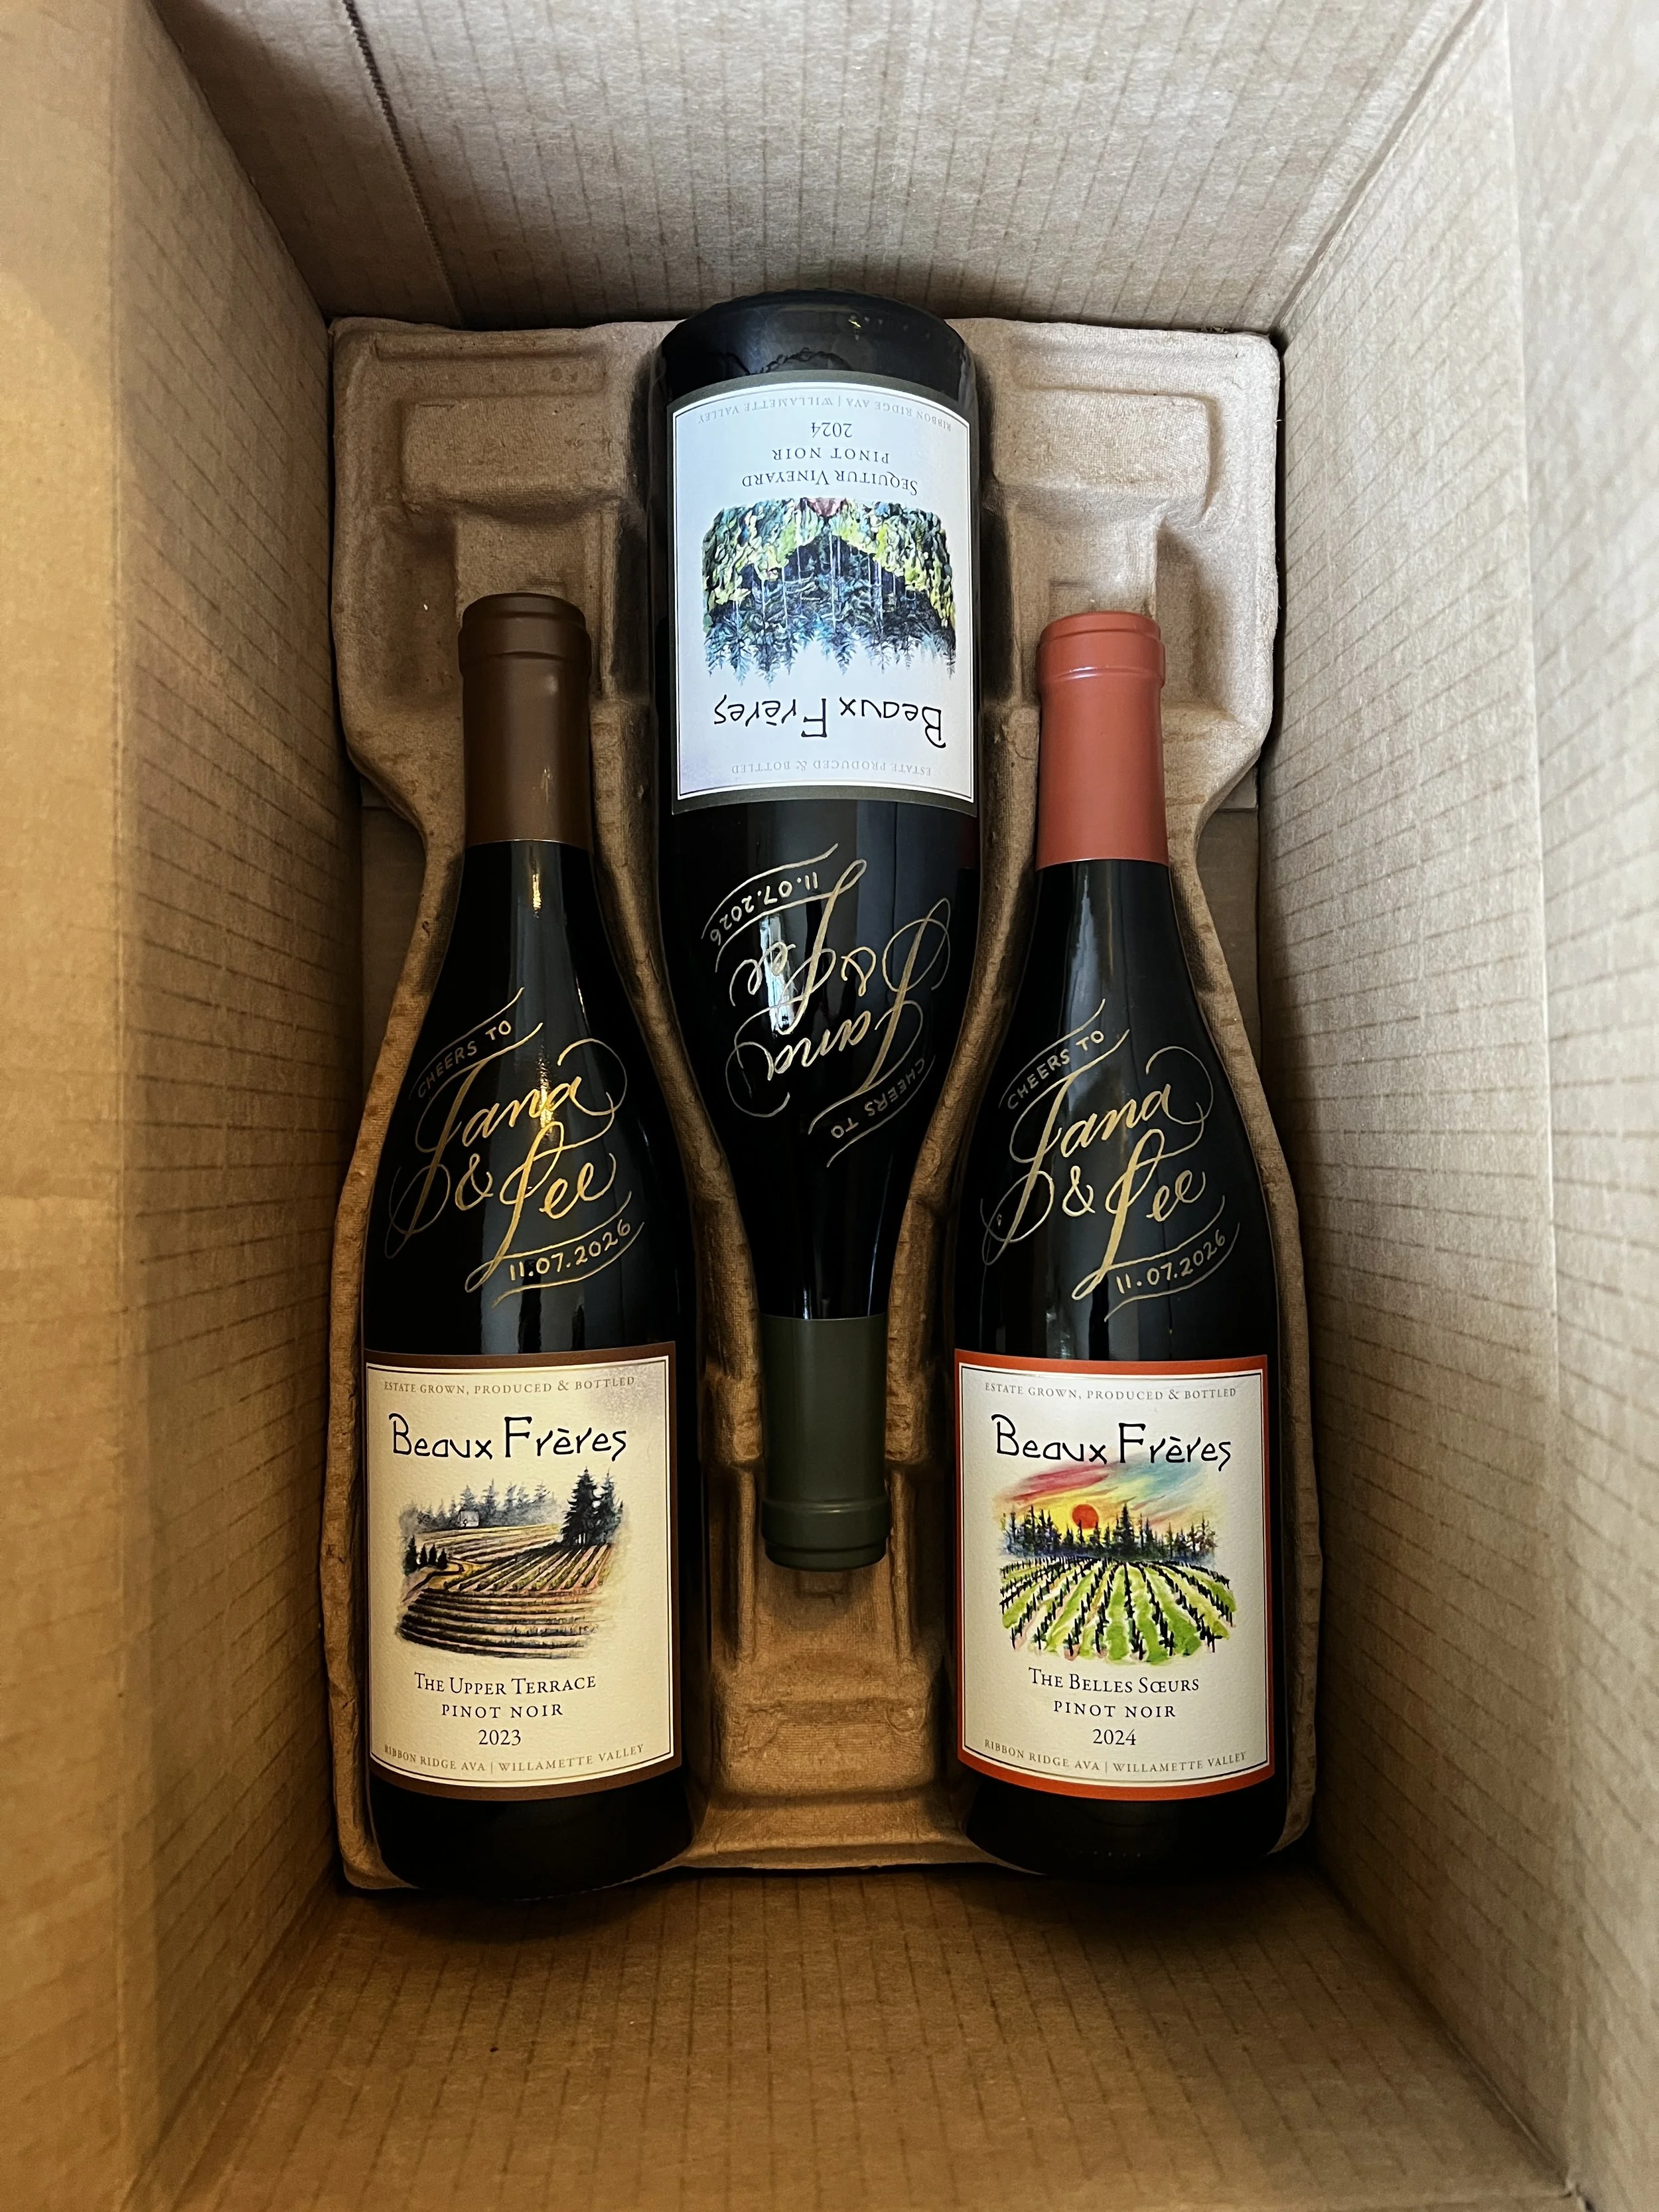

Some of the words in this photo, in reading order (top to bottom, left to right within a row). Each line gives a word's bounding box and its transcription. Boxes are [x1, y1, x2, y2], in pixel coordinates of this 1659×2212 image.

[744, 397, 833, 411] WILLAMETTE
[847, 398, 870, 409] AVA
[875, 401, 912, 416] RIDGE
[698, 406, 739, 423] VALLEY
[917, 411, 952, 431] RIBBON
[810, 422, 853, 438] 2024
[772, 447, 821, 461] NOIR
[830, 447, 889, 464] PINOT
[714, 694, 828, 737] Frères
[839, 697, 946, 748] Beaux
[732, 761, 790, 774] BOTTLED
[797, 761, 807, 770] &
[813, 760, 886, 771] PRODUCED
[891, 763, 931, 776] ESTATE
[710, 872, 818, 944] 11.07.2026
[841, 946, 876, 996] &
[418, 1044, 477, 1098] CHEERS
[485, 1021, 511, 1040] TO
[1008, 1049, 1070, 1110] CHEERS
[1076, 1031, 1104, 1051] TO
[865, 1058, 925, 1116] CHEERS
[831, 1118, 859, 1138] TO
[455, 1153, 494, 1211] &
[1062, 1166, 1095, 1216] &
[465, 1121, 616, 1293] Lee
[1072, 1129, 1206, 1300] Lee
[510, 1218, 631, 1281] 11.07.2026
[1116, 1229, 1226, 1293] 11.07.2026
[384, 1381, 415, 1392] ESTATE
[420, 1384, 469, 1395] GROWN,
[474, 1383, 551, 1394] PRODUCED
[557, 1380, 569, 1391] &
[575, 1376, 634, 1390] BOTTLED
[985, 1382, 1023, 1394] ESTATE
[1028, 1387, 1081, 1398] GROWN,
[1087, 1390, 1163, 1400] PRODUCED
[1169, 1389, 1179, 1399] &
[1185, 1388, 1236, 1398] BOTTLED
[389, 1413, 492, 1459] Beaux
[504, 1416, 626, 1461] Frères
[991, 1414, 1108, 1465] Beaux
[1118, 1423, 1231, 1471] Frères
[441, 1704, 500, 1718] PINOT
[510, 1704, 563, 1718] NOIR
[1054, 1700, 1115, 1718] PINOT
[1125, 1706, 1175, 1718] NOIR
[478, 1730, 522, 1745] 2023
[1092, 1728, 1137, 1746] 2024
[384, 1744, 416, 1763] RIBBON
[420, 1756, 456, 1770] RIDGE
[461, 1761, 485, 1771] AVA
[498, 1755, 593, 1771] WILLAMETTE
[599, 1743, 644, 1762] VALLEY
[984, 1739, 1024, 1759] RIBBON
[1029, 1752, 1069, 1767] RIDGE
[1075, 1761, 1099, 1771] AVA
[1113, 1760, 1203, 1773] WILLAMETTE
[1208, 1751, 1246, 1767] VALLEY
